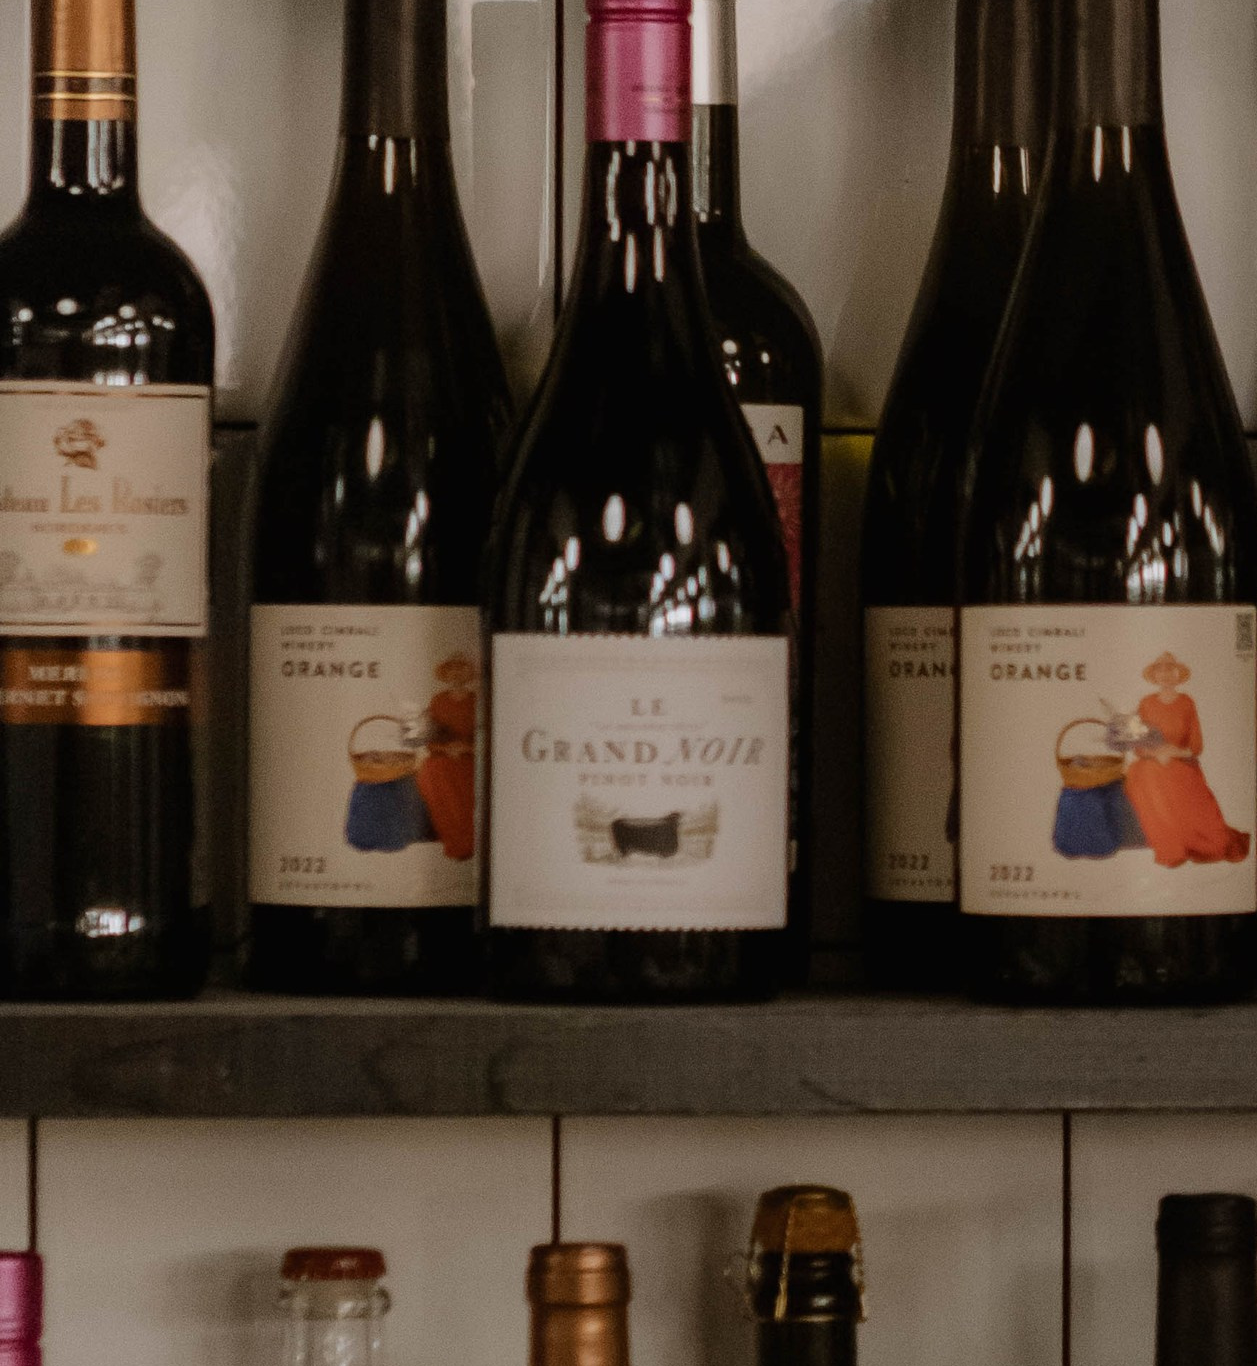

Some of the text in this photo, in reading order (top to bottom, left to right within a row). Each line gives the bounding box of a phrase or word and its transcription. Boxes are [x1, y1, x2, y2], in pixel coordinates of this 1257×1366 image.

[281, 661, 380, 679] ORANGE
[889, 661, 954, 678] ORAN
[990, 663, 1087, 681] ORANGE
[631, 697, 665, 716] LE
[521, 729, 765, 766] GRAND NOIR
